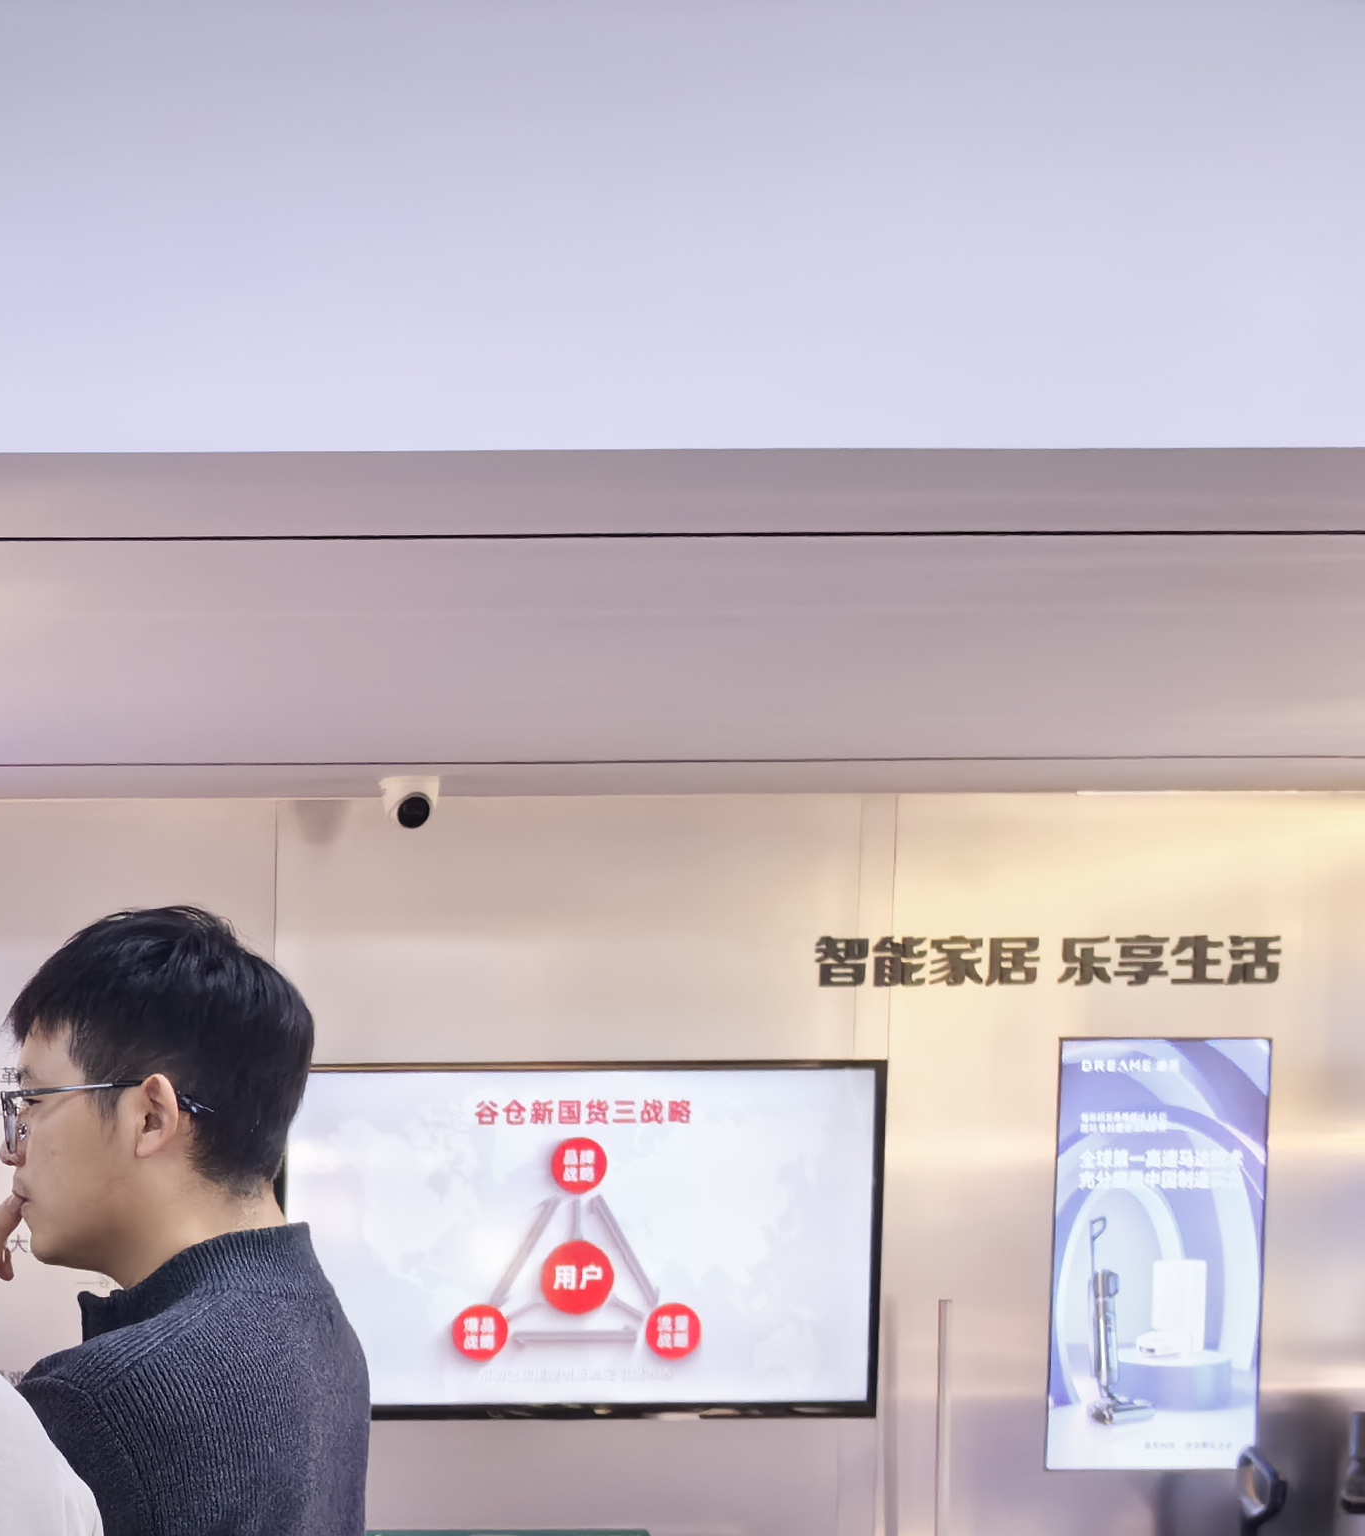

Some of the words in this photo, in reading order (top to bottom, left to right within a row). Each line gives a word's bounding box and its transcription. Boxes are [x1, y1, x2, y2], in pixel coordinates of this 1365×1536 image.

[815, 936, 1040, 987] 智能家居
[1058, 935, 1281, 986] 乐享生活
[475, 1100, 693, 1125] 谷仓新国货三战略
[553, 1265, 603, 1290] 用户
